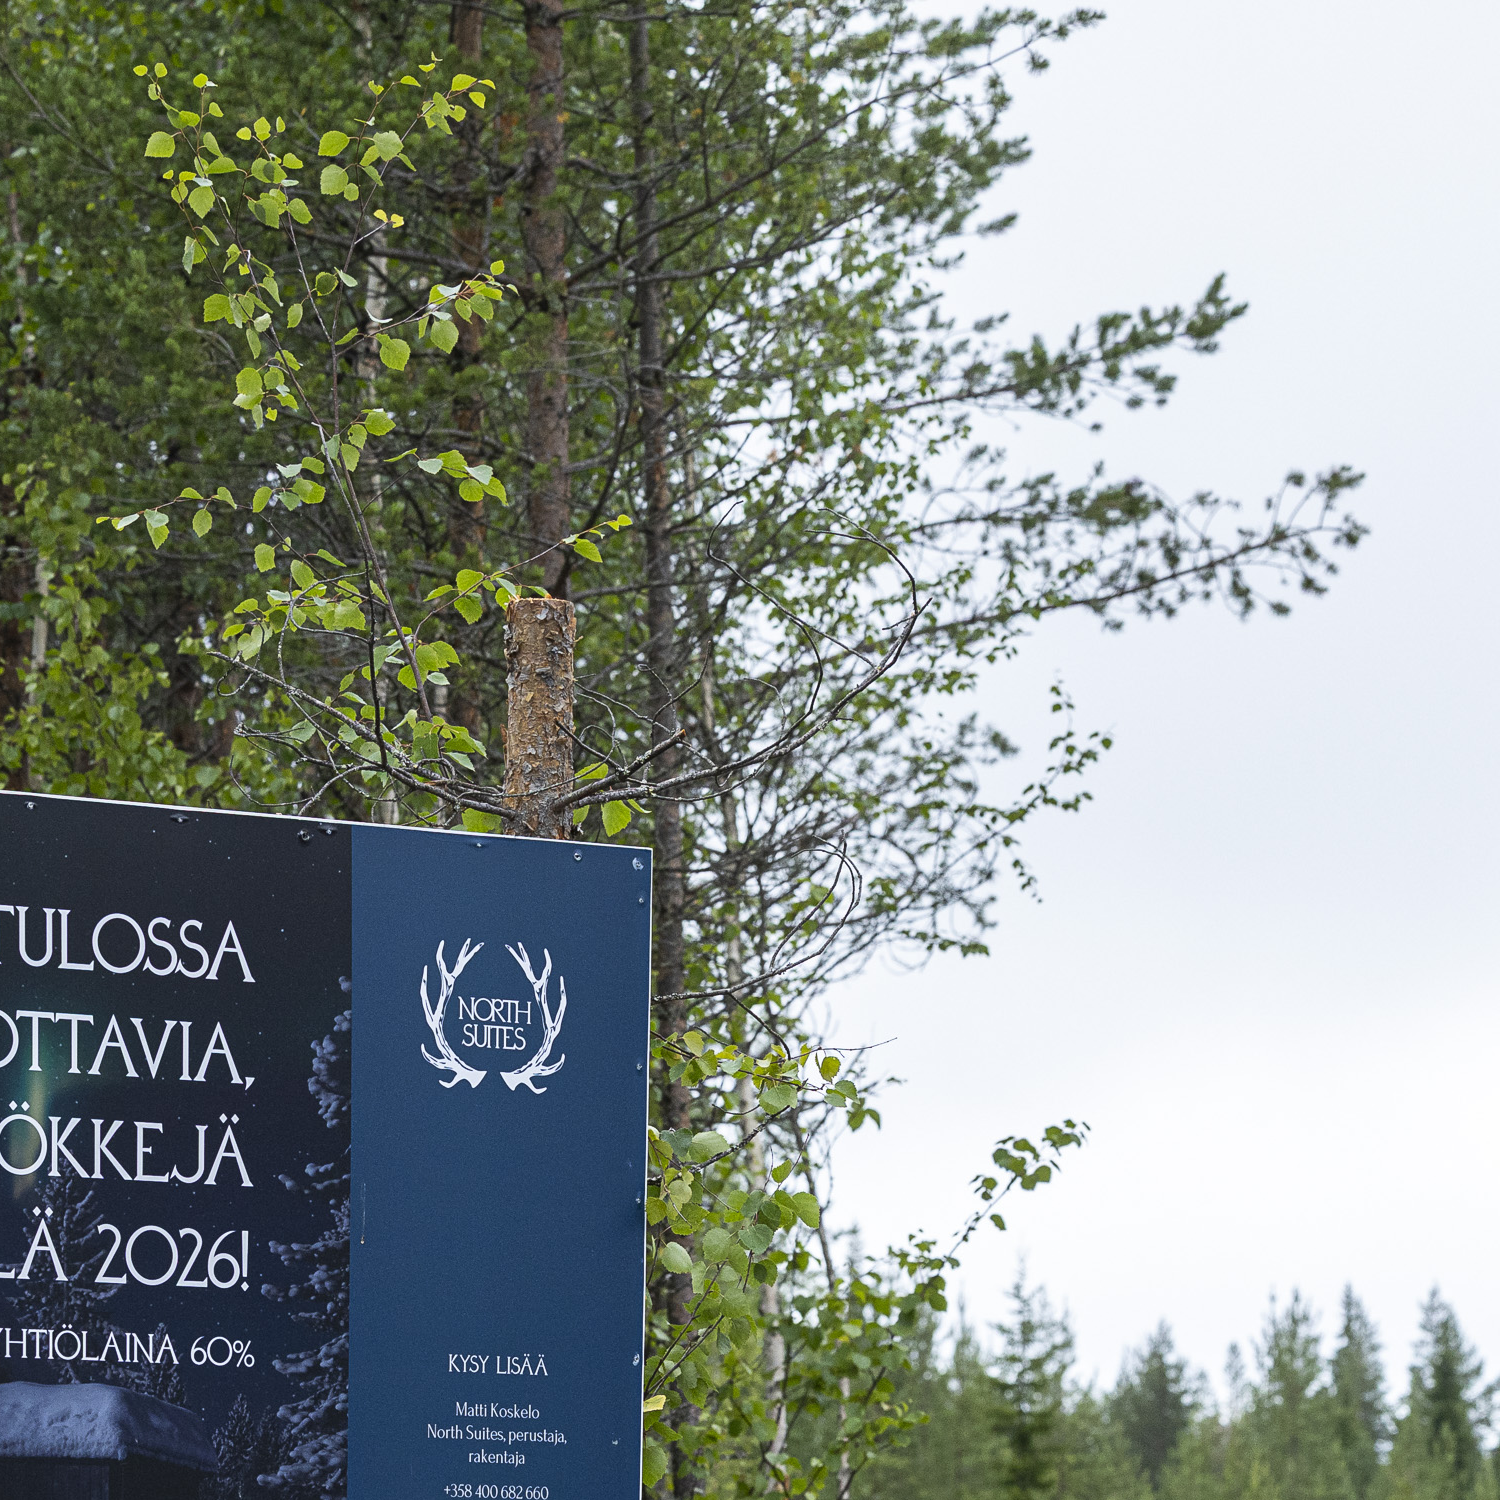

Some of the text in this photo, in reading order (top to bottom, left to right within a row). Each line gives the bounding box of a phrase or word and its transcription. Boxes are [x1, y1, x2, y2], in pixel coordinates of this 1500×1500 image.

[457, 996, 532, 1025] NORTH
[461, 1023, 527, 1051] SUITES
[94, 1223, 250, 1292] 2026!
[190, 1336, 255, 1368] 60%
[448, 1353, 549, 1376] KYSY LISÄÄ
[455, 1401, 540, 1419] Matti Koskelo
[427, 1423, 567, 1446] North Suites, perustaja,
[468, 1448, 525, 1467] rakentaja
[443, 1483, 549, 1500] +358 400 682 660
